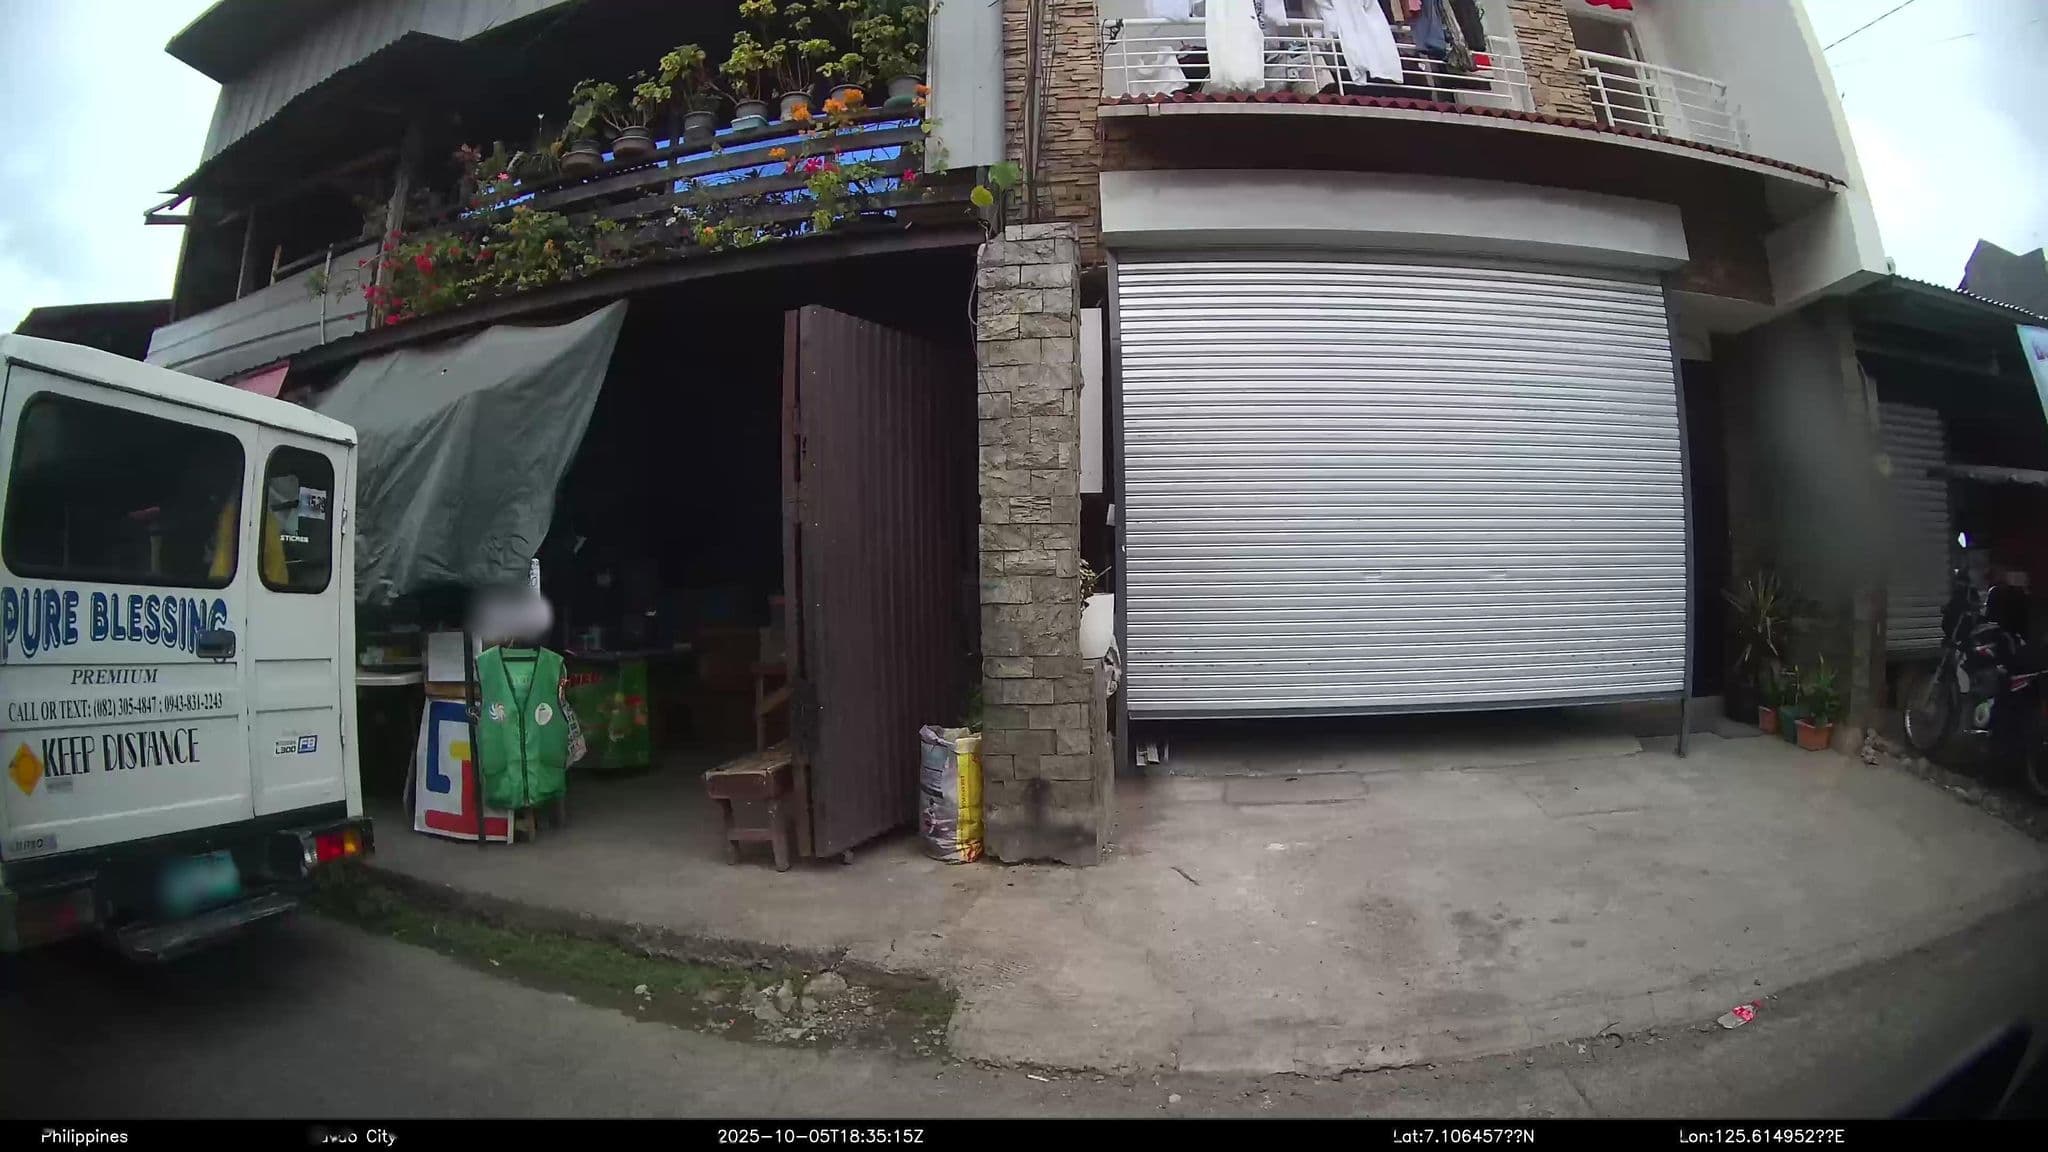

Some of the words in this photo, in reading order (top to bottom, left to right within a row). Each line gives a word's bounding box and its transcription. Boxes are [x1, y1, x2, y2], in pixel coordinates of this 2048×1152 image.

[0, 587, 79, 663] PURE
[71, 669, 158, 685] PREMIUM
[8, 702, 38, 722] CALL
[41, 701, 57, 720] OR
[59, 699, 92, 719] TEXT:
[93, 698, 116, 718] (082)
[118, 696, 156, 715] 305-4847
[41, 735, 96, 778] KEEP
[102, 728, 200, 772] DISTANCE
